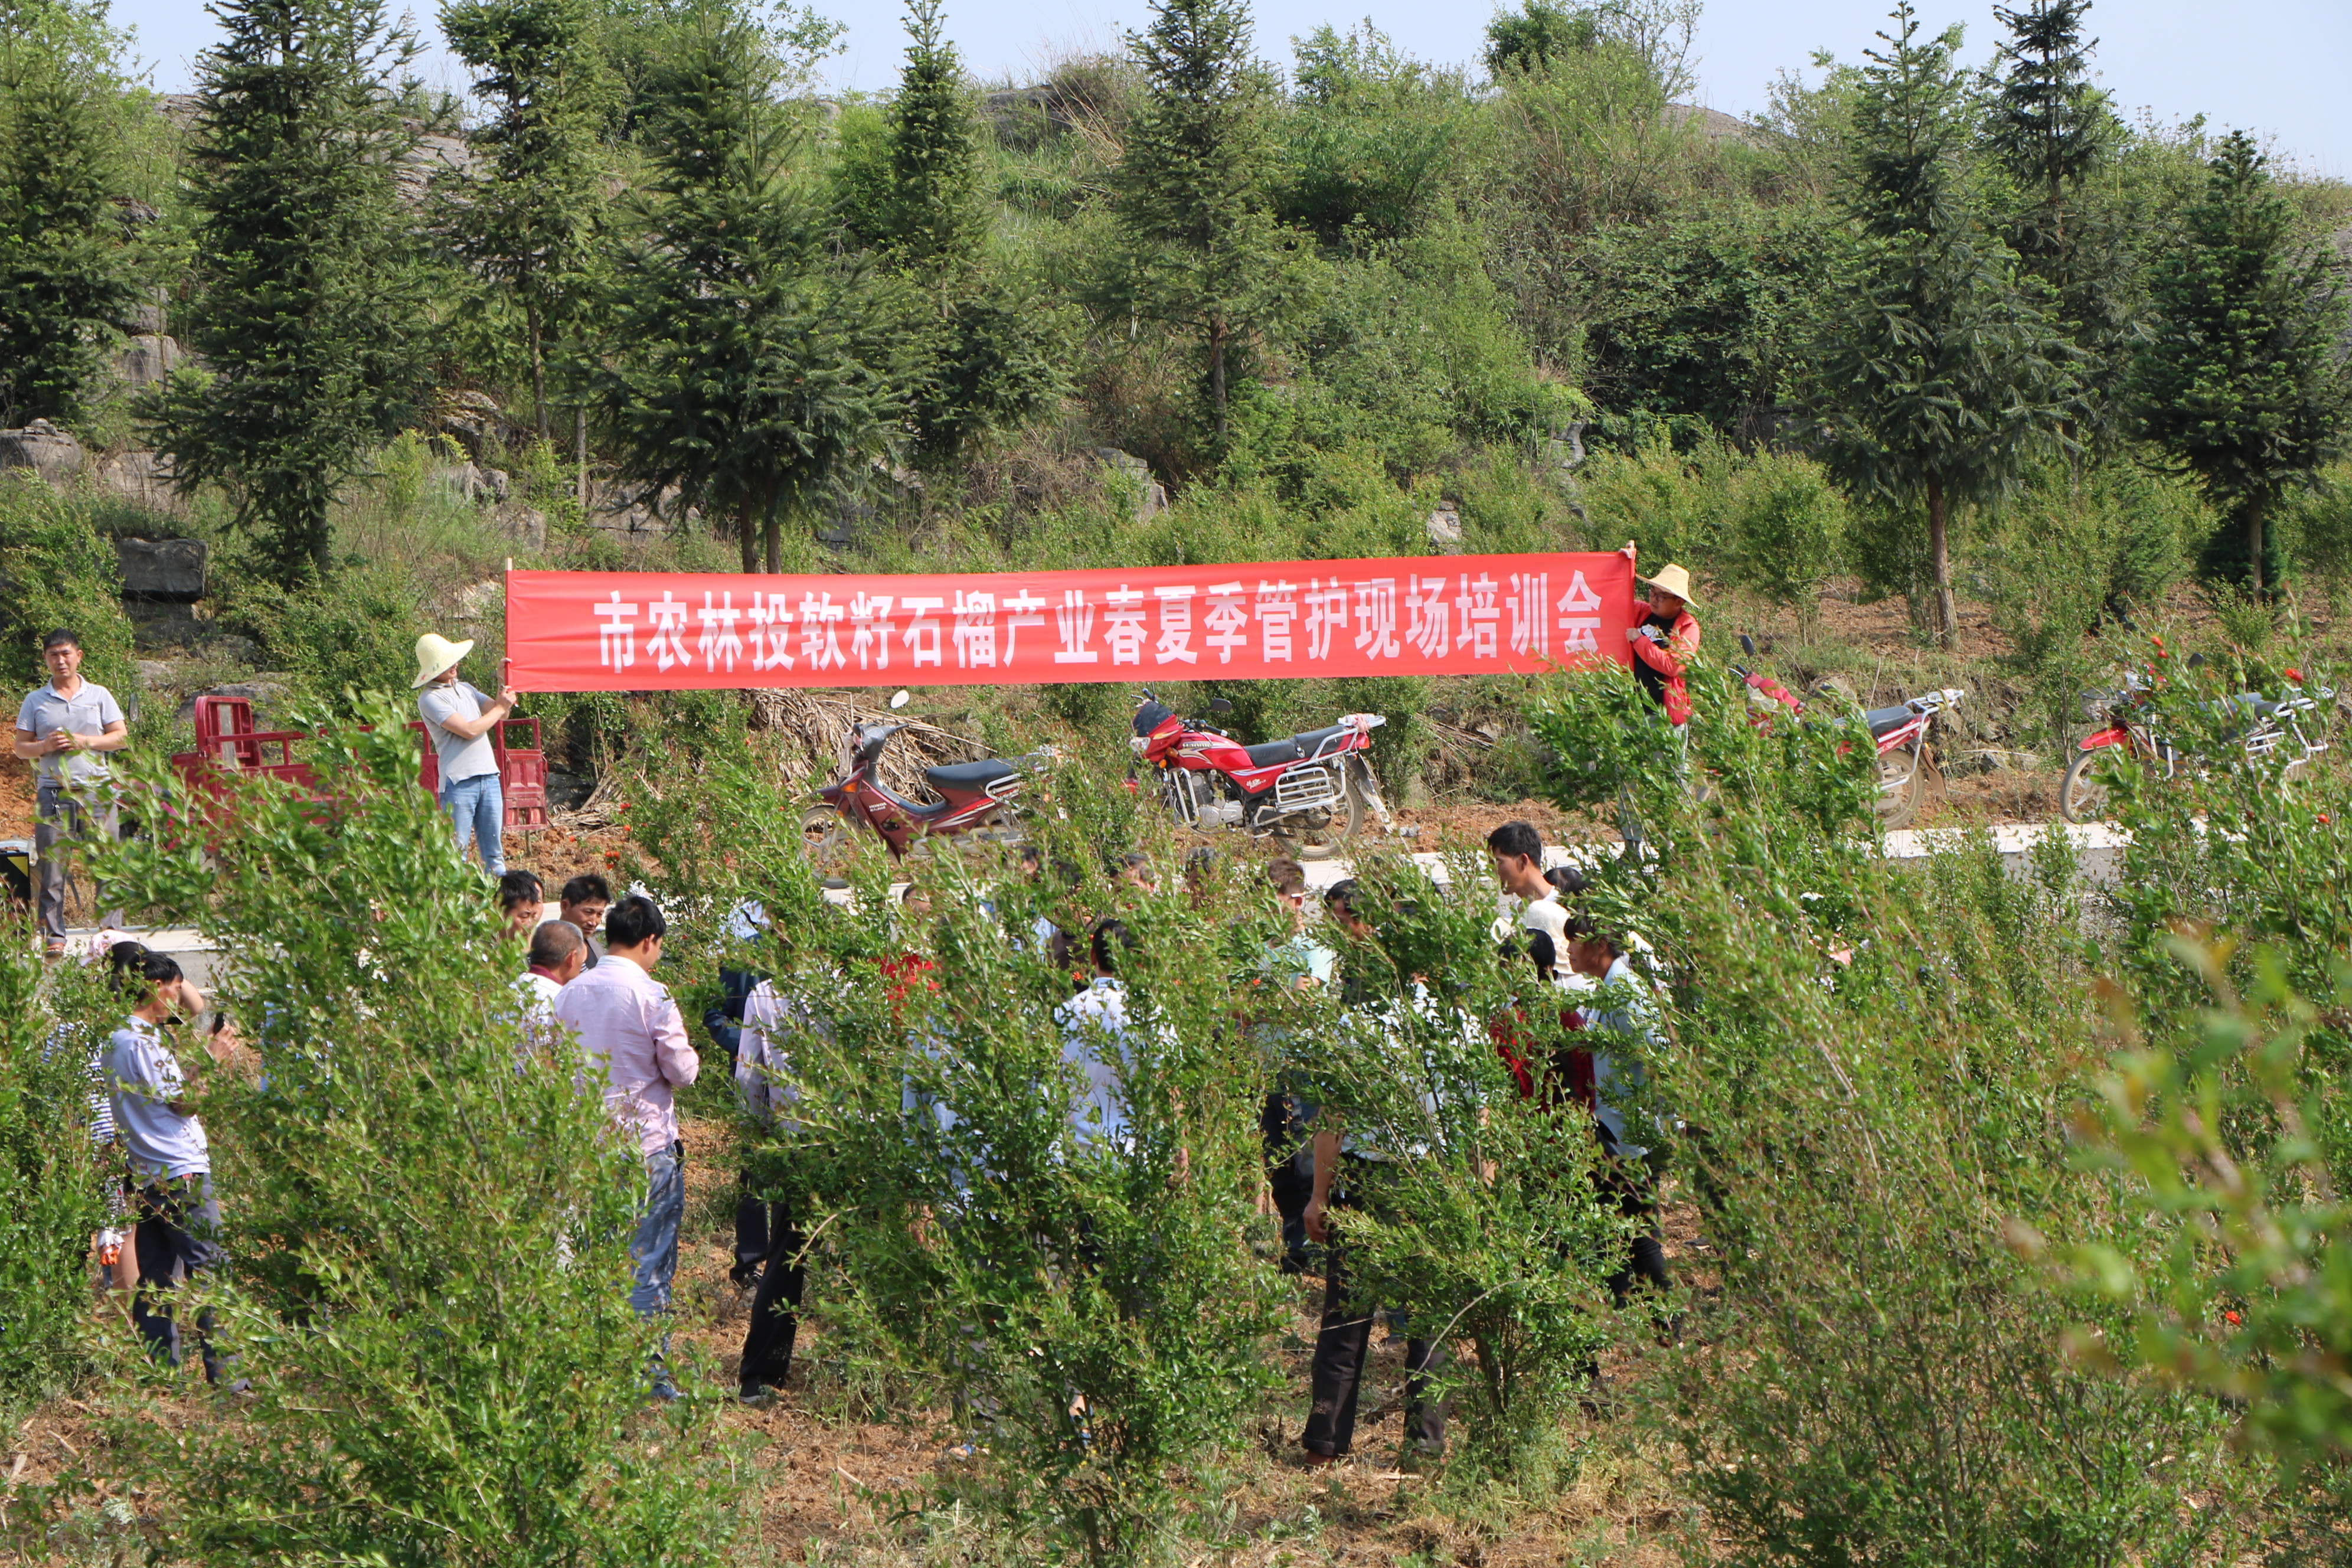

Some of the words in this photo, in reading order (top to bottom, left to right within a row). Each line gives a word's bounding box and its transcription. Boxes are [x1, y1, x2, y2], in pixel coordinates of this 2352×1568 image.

[593, 570, 1602, 674] 市农林投软籽石榴产业春夏季管护现场培训会
